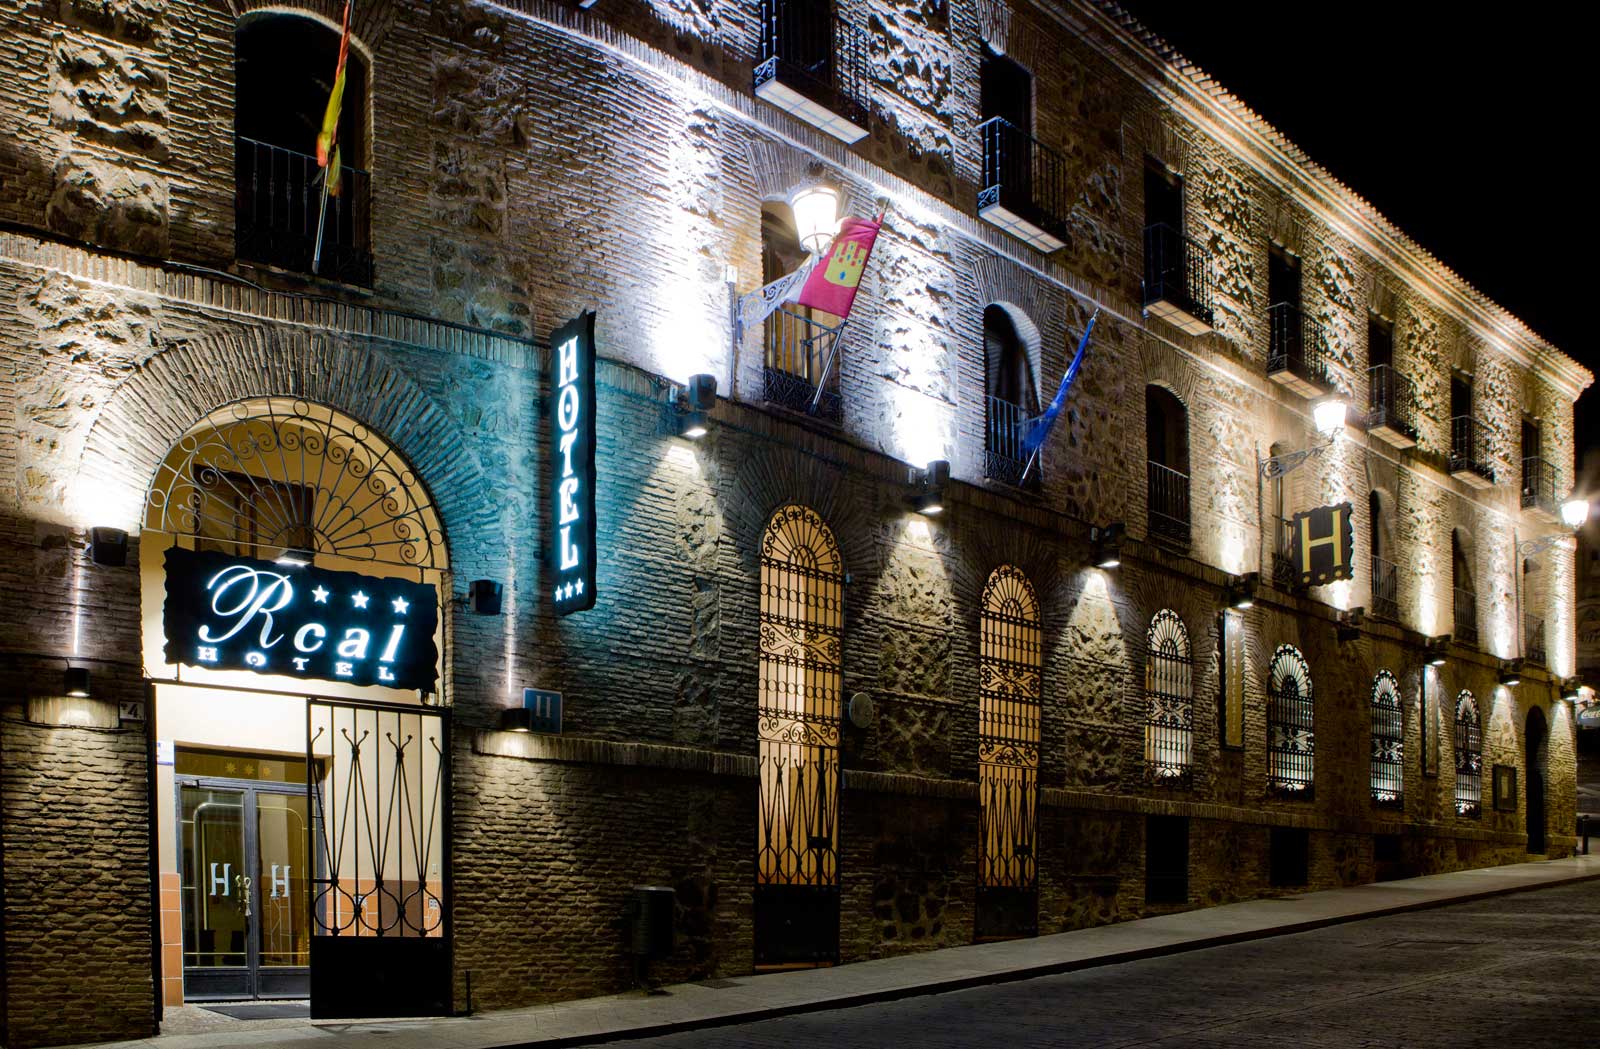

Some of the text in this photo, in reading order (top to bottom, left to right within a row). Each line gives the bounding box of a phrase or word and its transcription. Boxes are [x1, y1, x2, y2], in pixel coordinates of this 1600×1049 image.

[557, 335, 579, 571] HOTEL
[1301, 509, 1342, 573] H
[197, 646, 395, 681] HOTEL
[209, 862, 231, 896] H
[271, 864, 291, 897] H
